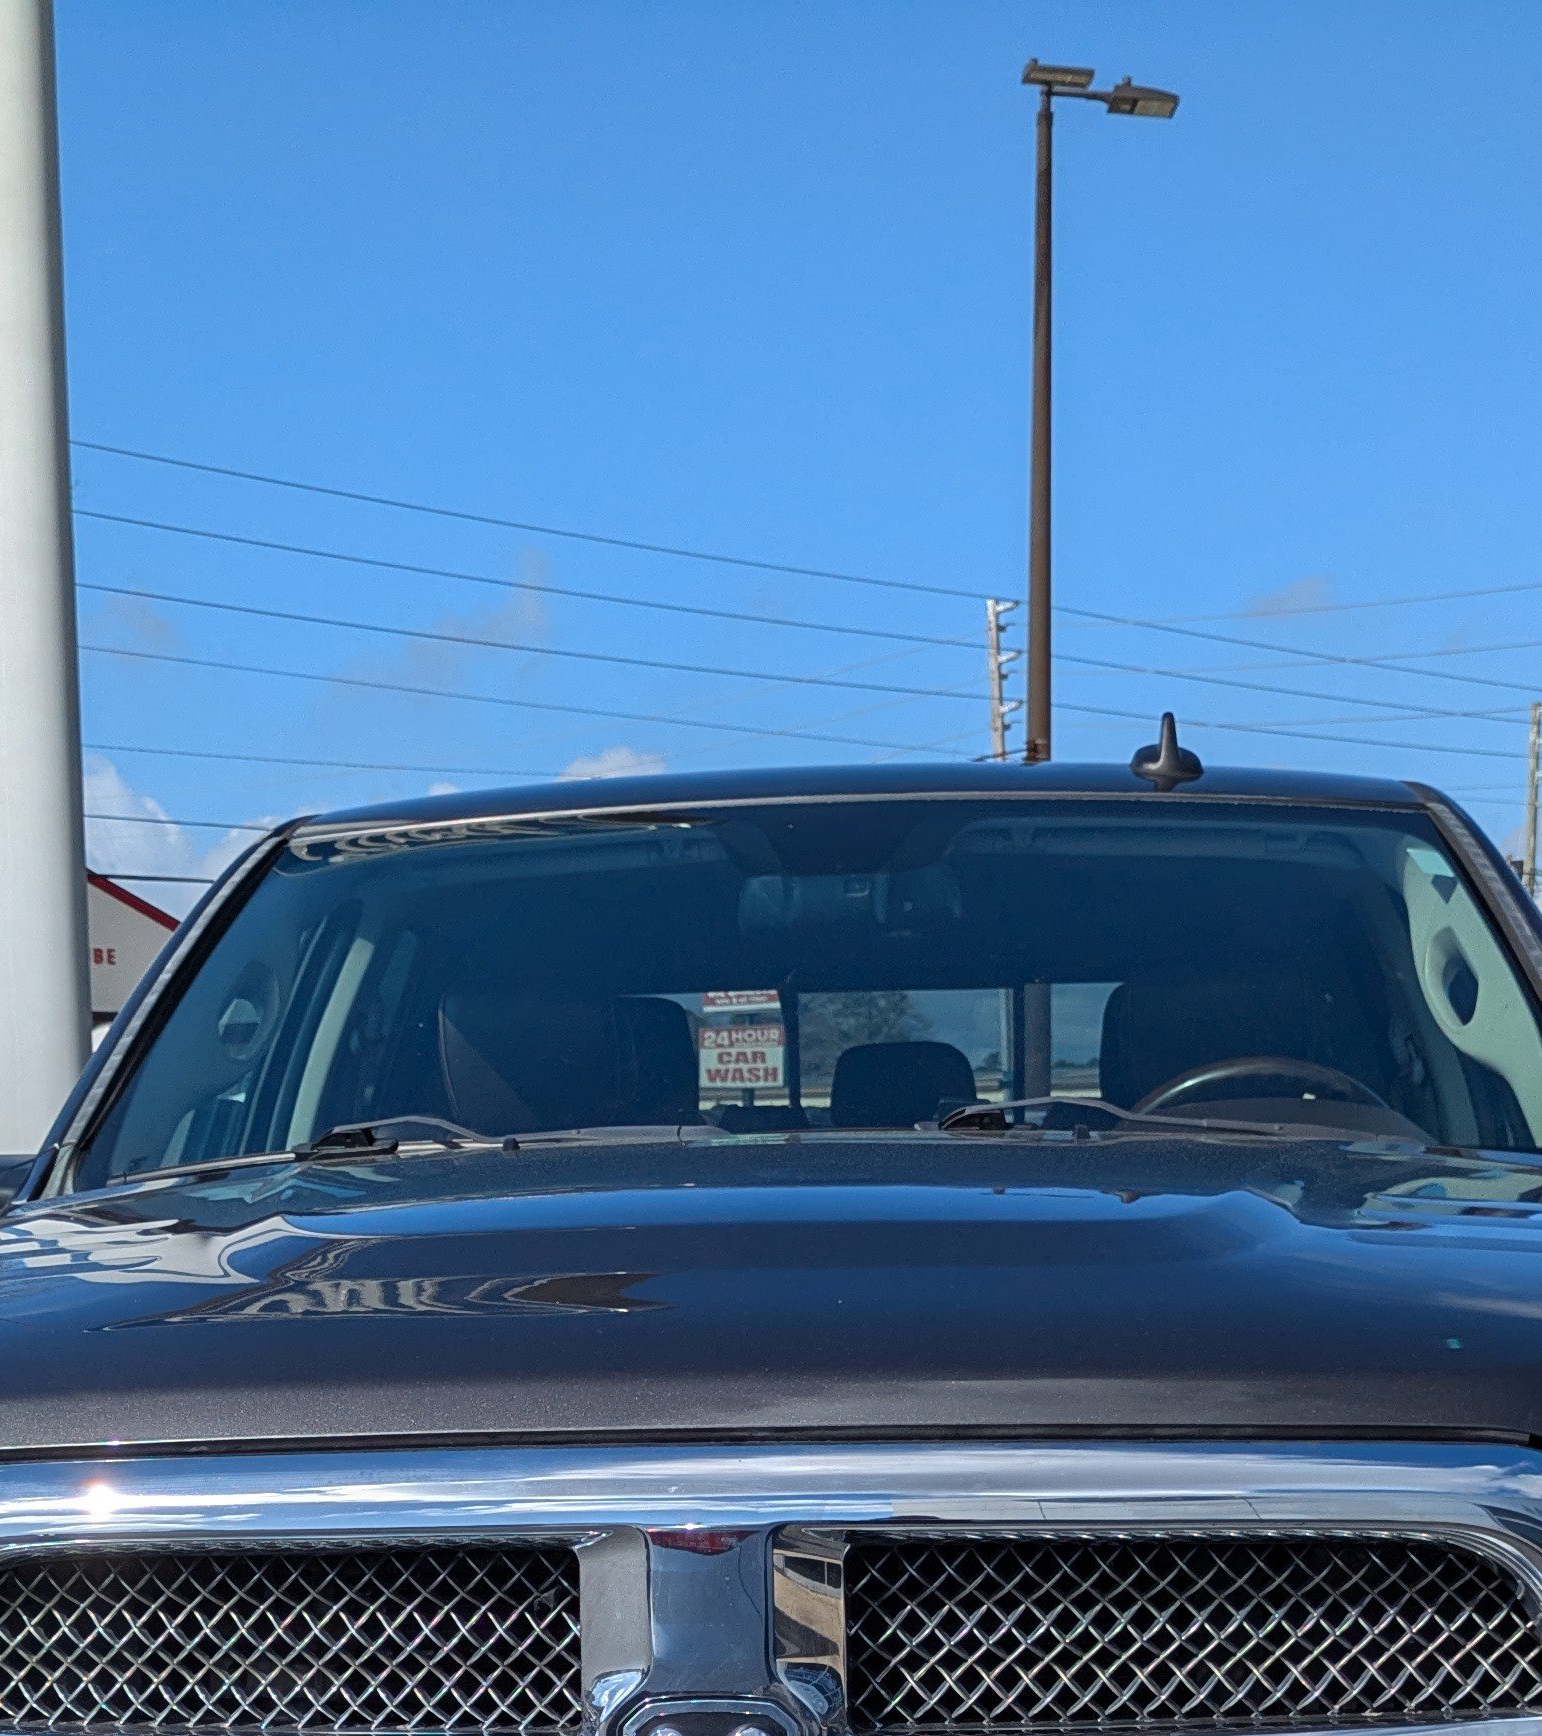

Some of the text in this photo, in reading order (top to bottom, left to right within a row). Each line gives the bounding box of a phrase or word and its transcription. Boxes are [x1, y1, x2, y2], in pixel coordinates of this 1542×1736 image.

[704, 1028, 780, 1048] 24 HOUR
[717, 1051, 767, 1065] CAR
[706, 1067, 778, 1083] WASH
